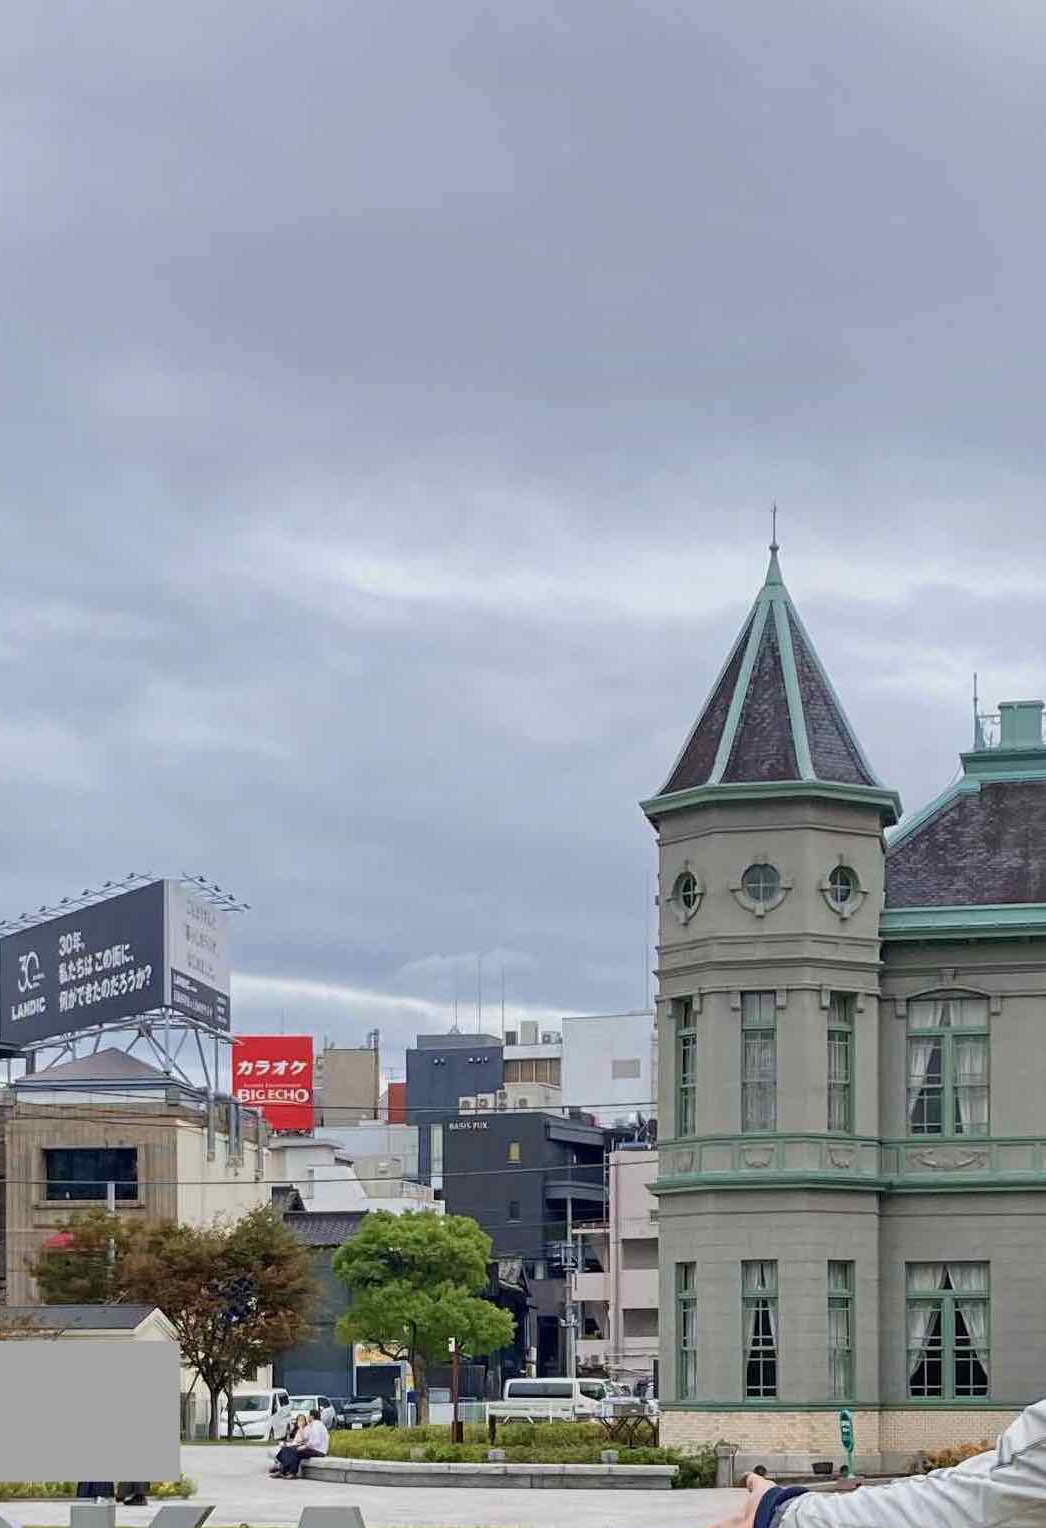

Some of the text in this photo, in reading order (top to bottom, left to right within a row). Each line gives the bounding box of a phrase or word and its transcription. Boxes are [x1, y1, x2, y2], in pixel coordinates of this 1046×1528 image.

[11, 996, 46, 1021] LANDIC
[236, 1060, 307, 1076] カラオケ
[237, 1088, 309, 1104] BIG ECHO
